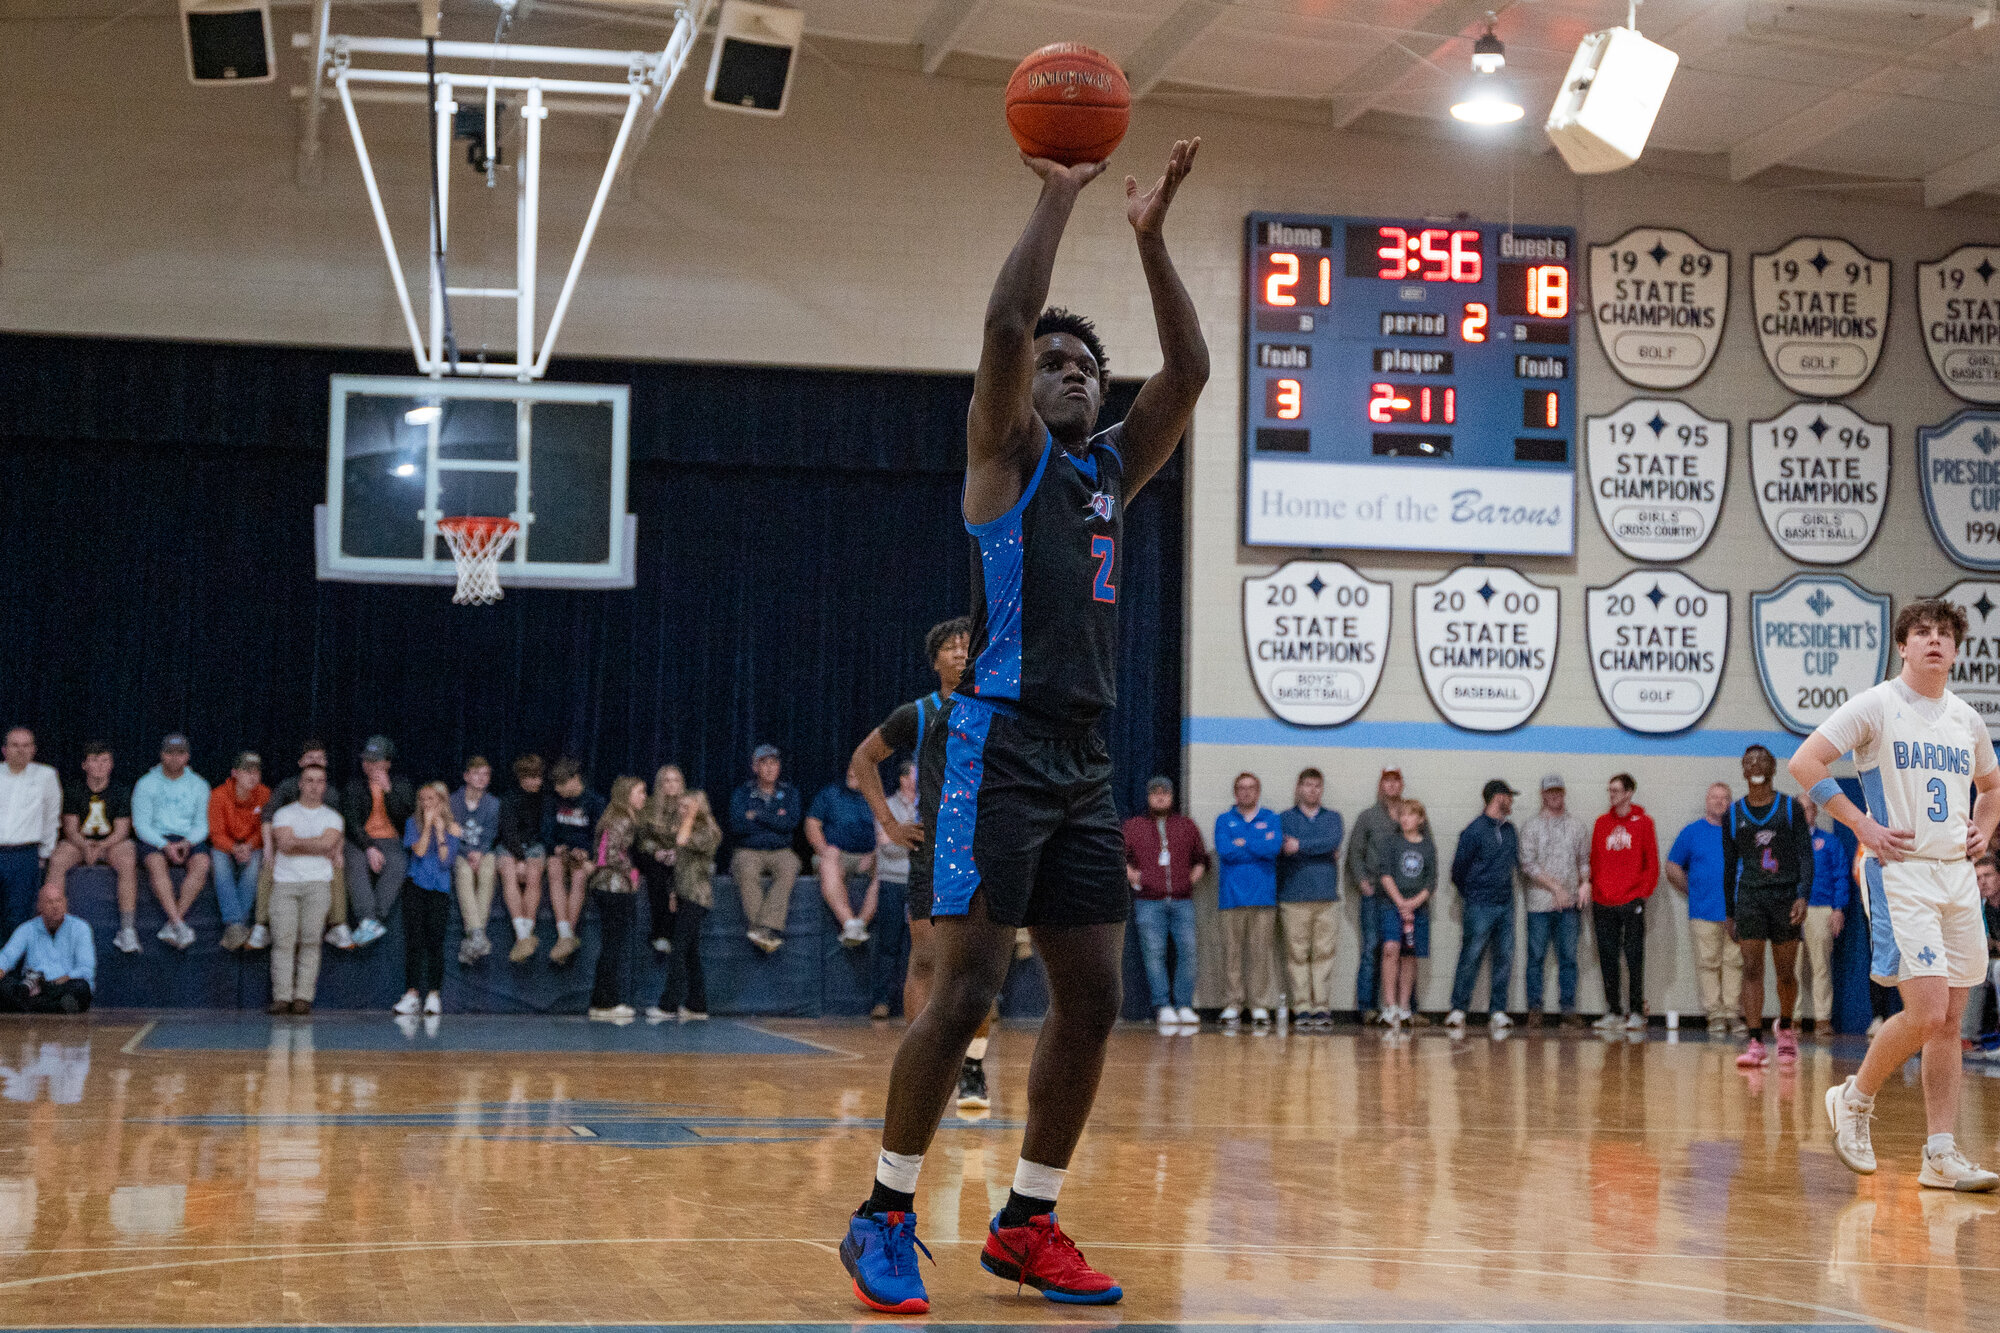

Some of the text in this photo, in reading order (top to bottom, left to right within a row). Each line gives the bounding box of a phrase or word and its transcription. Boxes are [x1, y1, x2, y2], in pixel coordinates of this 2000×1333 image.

[1268, 223, 1321, 247] Home
[1501, 234, 1566, 259] Guests
[1378, 226, 1482, 283] 3:56
[1610, 251, 1713, 278] 19 89
[1265, 252, 1331, 306] 21
[1772, 259, 1872, 285] 19 91
[1938, 268, 1964, 290] 19
[1526, 265, 1569, 318] 18
[1616, 280, 1695, 304] STATE
[1778, 290, 1858, 315] STATE
[1382, 314, 1445, 336] period
[1462, 302, 1488, 342] 2
[1599, 303, 1716, 330] CHAMPIONS
[1762, 314, 1878, 341] CHAMPIONS
[1262, 345, 1307, 368] fouls
[1381, 351, 1443, 374] player
[1639, 345, 1678, 360] GOLF
[1801, 355, 1840, 370] GOLF
[1519, 357, 1564, 378] fouls
[1277, 379, 1301, 419] 3
[1546, 392, 1558, 427] 1
[1608, 423, 1709, 449] 19 95
[1771, 427, 1871, 450] 19 96
[1617, 454, 1699, 478] STATE
[1780, 457, 1861, 481] STATE
[1600, 479, 1716, 504] CHAMPIONS
[1764, 481, 1879, 505] CHAMPIONS
[1260, 488, 1562, 528] Home of the Barons
[1639, 511, 1679, 523] GIRLS
[1620, 523, 1698, 537] CROSS COUNTRY
[1785, 527, 1856, 540] BASKETBALL
[1091, 533, 1116, 603] 2
[1267, 585, 1369, 607] 20 00
[1433, 590, 1539, 614] 20 00
[1606, 594, 1708, 617] 20 00
[1275, 615, 1358, 638] STATE
[1446, 622, 1528, 645] STATE
[1616, 626, 1698, 648] STATE
[1764, 621, 1878, 650] PRESIDENT'S
[1258, 640, 1375, 664] CHAMPIONS
[1429, 646, 1545, 670] CHAMPIONS
[1600, 650, 1715, 673] CHAMPIONS
[1804, 652, 1840, 677] CUP
[1455, 687, 1520, 699] BASEBALL
[1640, 688, 1675, 702] GOLF
[1797, 687, 1849, 709] 2000
[1893, 741, 1970, 776] BARONS
[1927, 778, 1949, 822] 3
